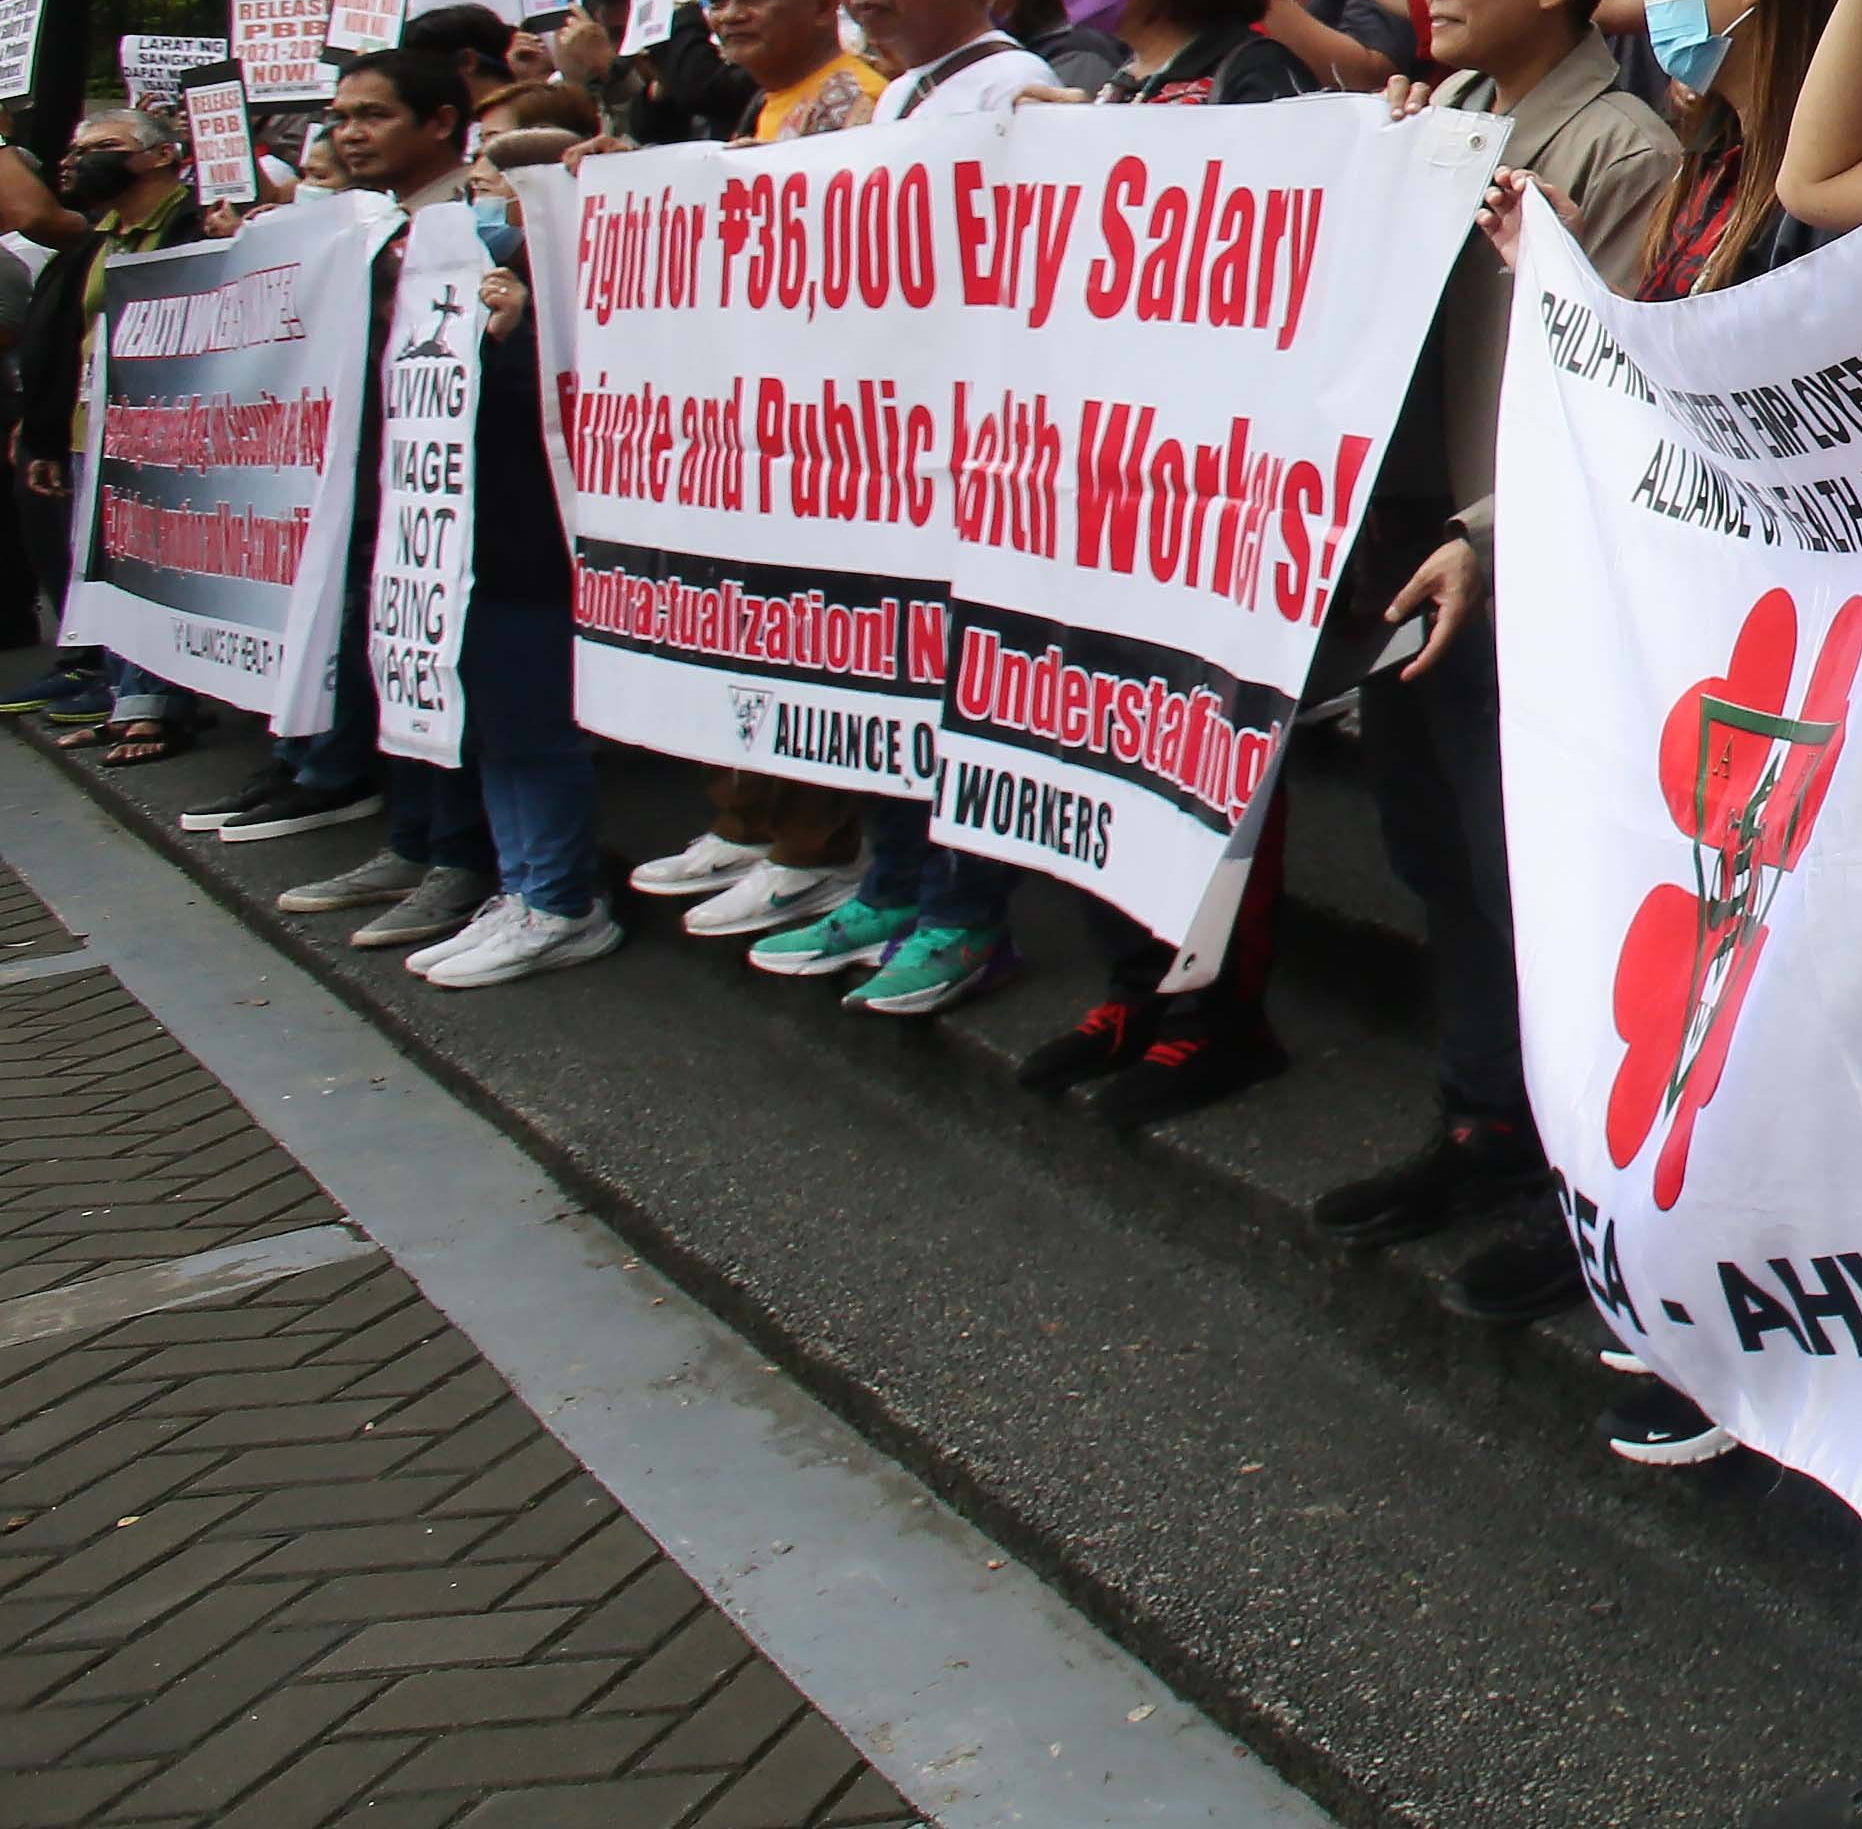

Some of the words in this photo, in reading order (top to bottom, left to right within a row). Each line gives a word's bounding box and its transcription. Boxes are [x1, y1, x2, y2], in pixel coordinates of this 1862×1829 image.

[244, 21, 326, 40] PBB
[253, 62, 317, 84] NOW!
[577, 191, 650, 325] Fight
[654, 186, 706, 309] for
[1086, 156, 1324, 350] Salary
[388, 365, 466, 419] LIVING
[679, 377, 744, 511] and
[757, 377, 934, 527] Public
[1631, 438, 1751, 540] ALLIANCE
[397, 506, 456, 569] NOT
[774, 703, 900, 775] ALLIANCE
[912, 722, 935, 779] O
[954, 761, 1113, 869] WORKERS
